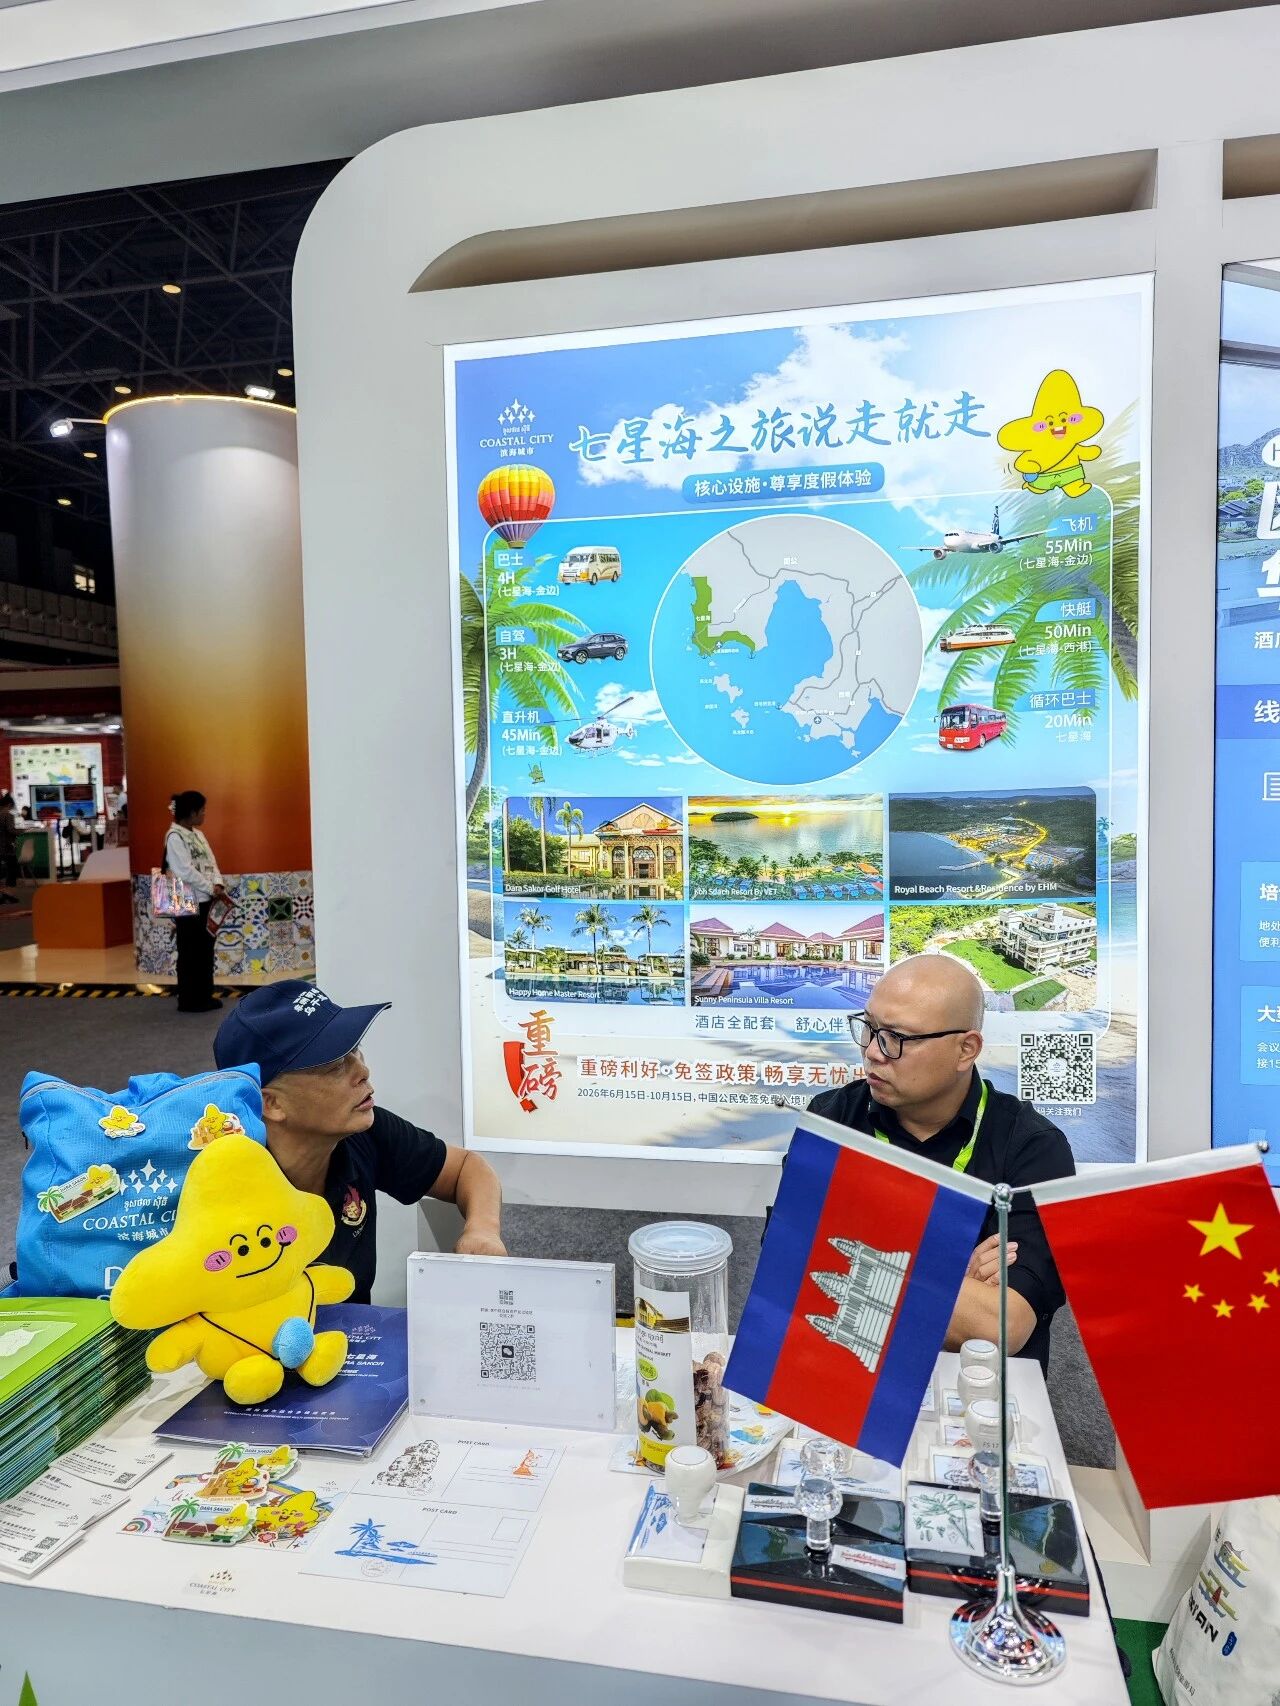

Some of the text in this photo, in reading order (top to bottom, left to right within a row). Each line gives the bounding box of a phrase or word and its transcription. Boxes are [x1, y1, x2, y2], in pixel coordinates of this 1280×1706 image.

[568, 391, 991, 464] 七星海之旅说走就走
[480, 434, 554, 448] COASTAL CITY
[693, 469, 872, 497] 核心设施·尊享度假体验
[1062, 516, 1093, 532] 飞机
[1045, 538, 1093, 555] 55Min
[498, 553, 523, 567] 巴士
[498, 572, 515, 585] 4H
[1061, 602, 1091, 617] 快艇
[500, 629, 525, 643] 自驾
[1045, 624, 1092, 640] 50Min
[500, 647, 517, 660] 3H
[1029, 691, 1092, 709] 循环巴士
[502, 710, 540, 724] 直升机
[1044, 715, 1093, 729] 20Min
[502, 728, 541, 742] 45Min
[505, 884, 580, 894] Dara Sakor Golf Hotel
[754, 888, 763, 897] By
[894, 885, 917, 895] Royal
[919, 884, 945, 893] Beach
[946, 884, 973, 893] Resort
[1025, 883, 1036, 893] by
[1037, 883, 1057, 891] EHM
[1259, 883, 1280, 901] 培
[509, 988, 601, 998] Happy Home Master Resort
[694, 995, 717, 1004] Sunny
[718, 996, 753, 1004] Peninsula
[770, 997, 794, 1005] Resort
[1257, 1005, 1280, 1022] 大
[695, 1014, 775, 1030] 酒店全配套
[580, 1058, 756, 1082] 重磅利好·免签政策
[83, 1209, 177, 1231] COASTAL CI
